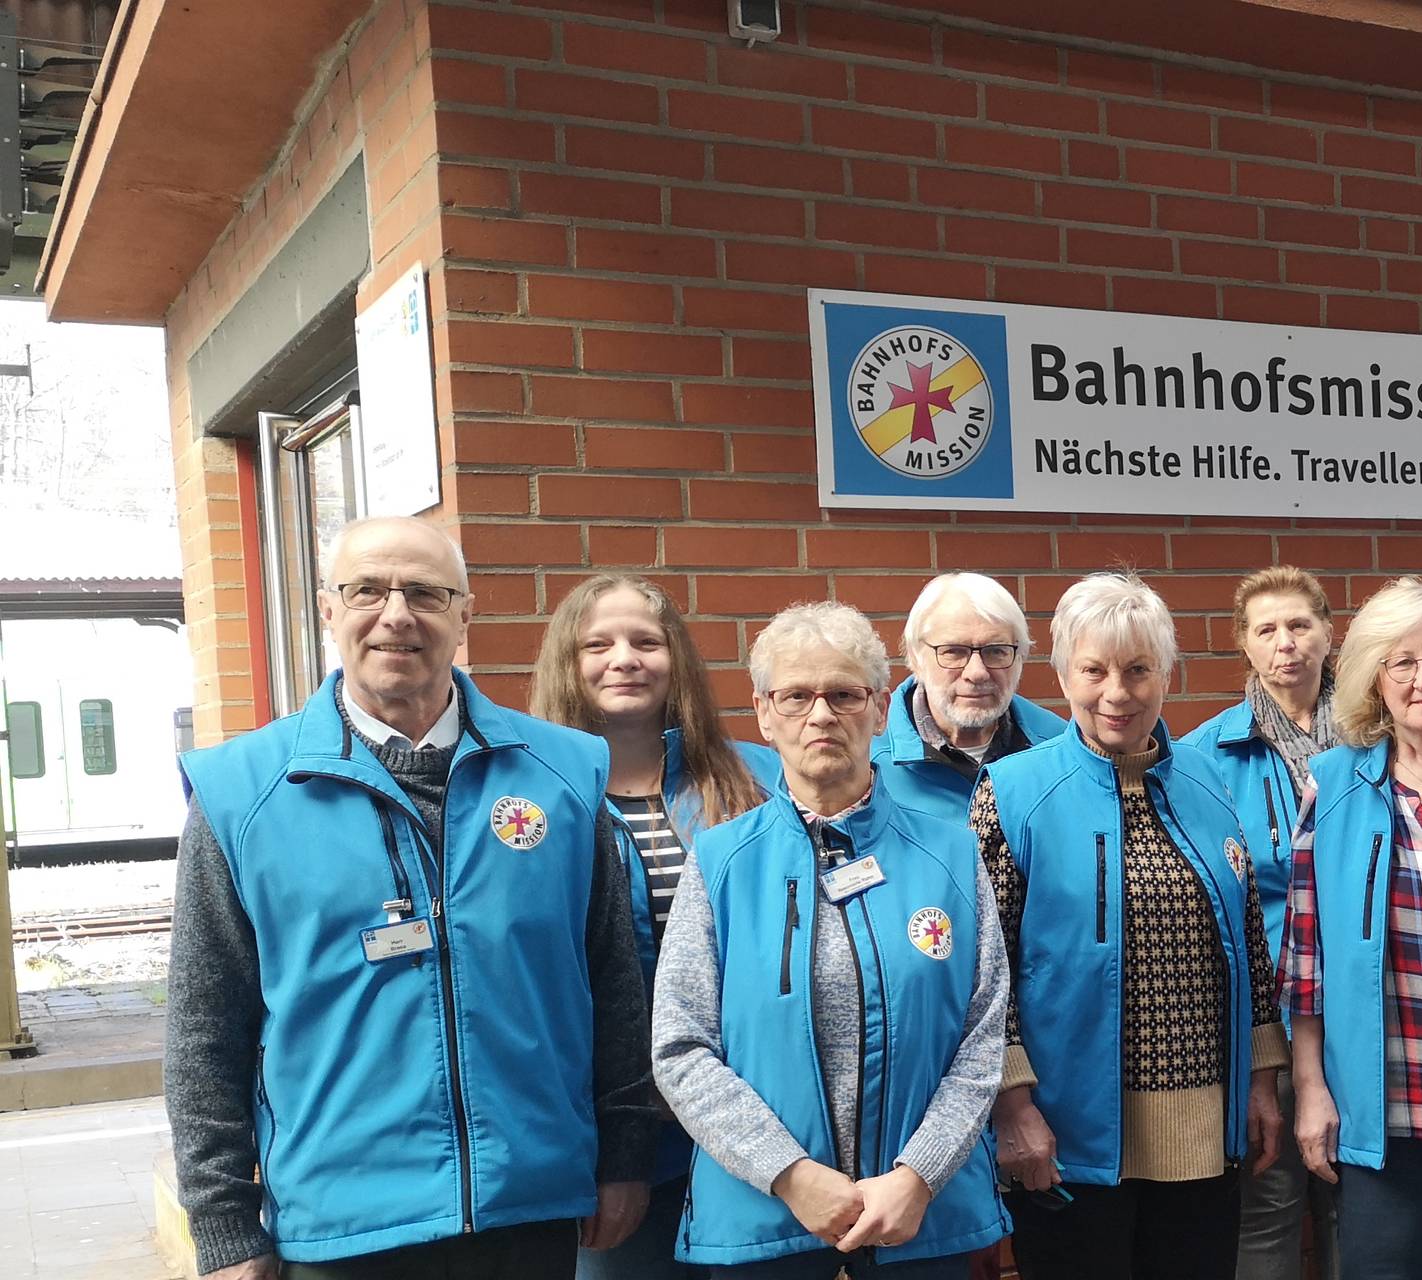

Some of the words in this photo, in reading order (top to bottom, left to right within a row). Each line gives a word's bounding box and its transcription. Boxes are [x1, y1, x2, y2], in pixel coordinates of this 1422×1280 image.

[858, 334, 952, 412] BAHNHOFS
[905, 406, 985, 470] MISSION
[1035, 438, 1181, 478] Nächste
[1193, 446, 1281, 481] Hilfe.
